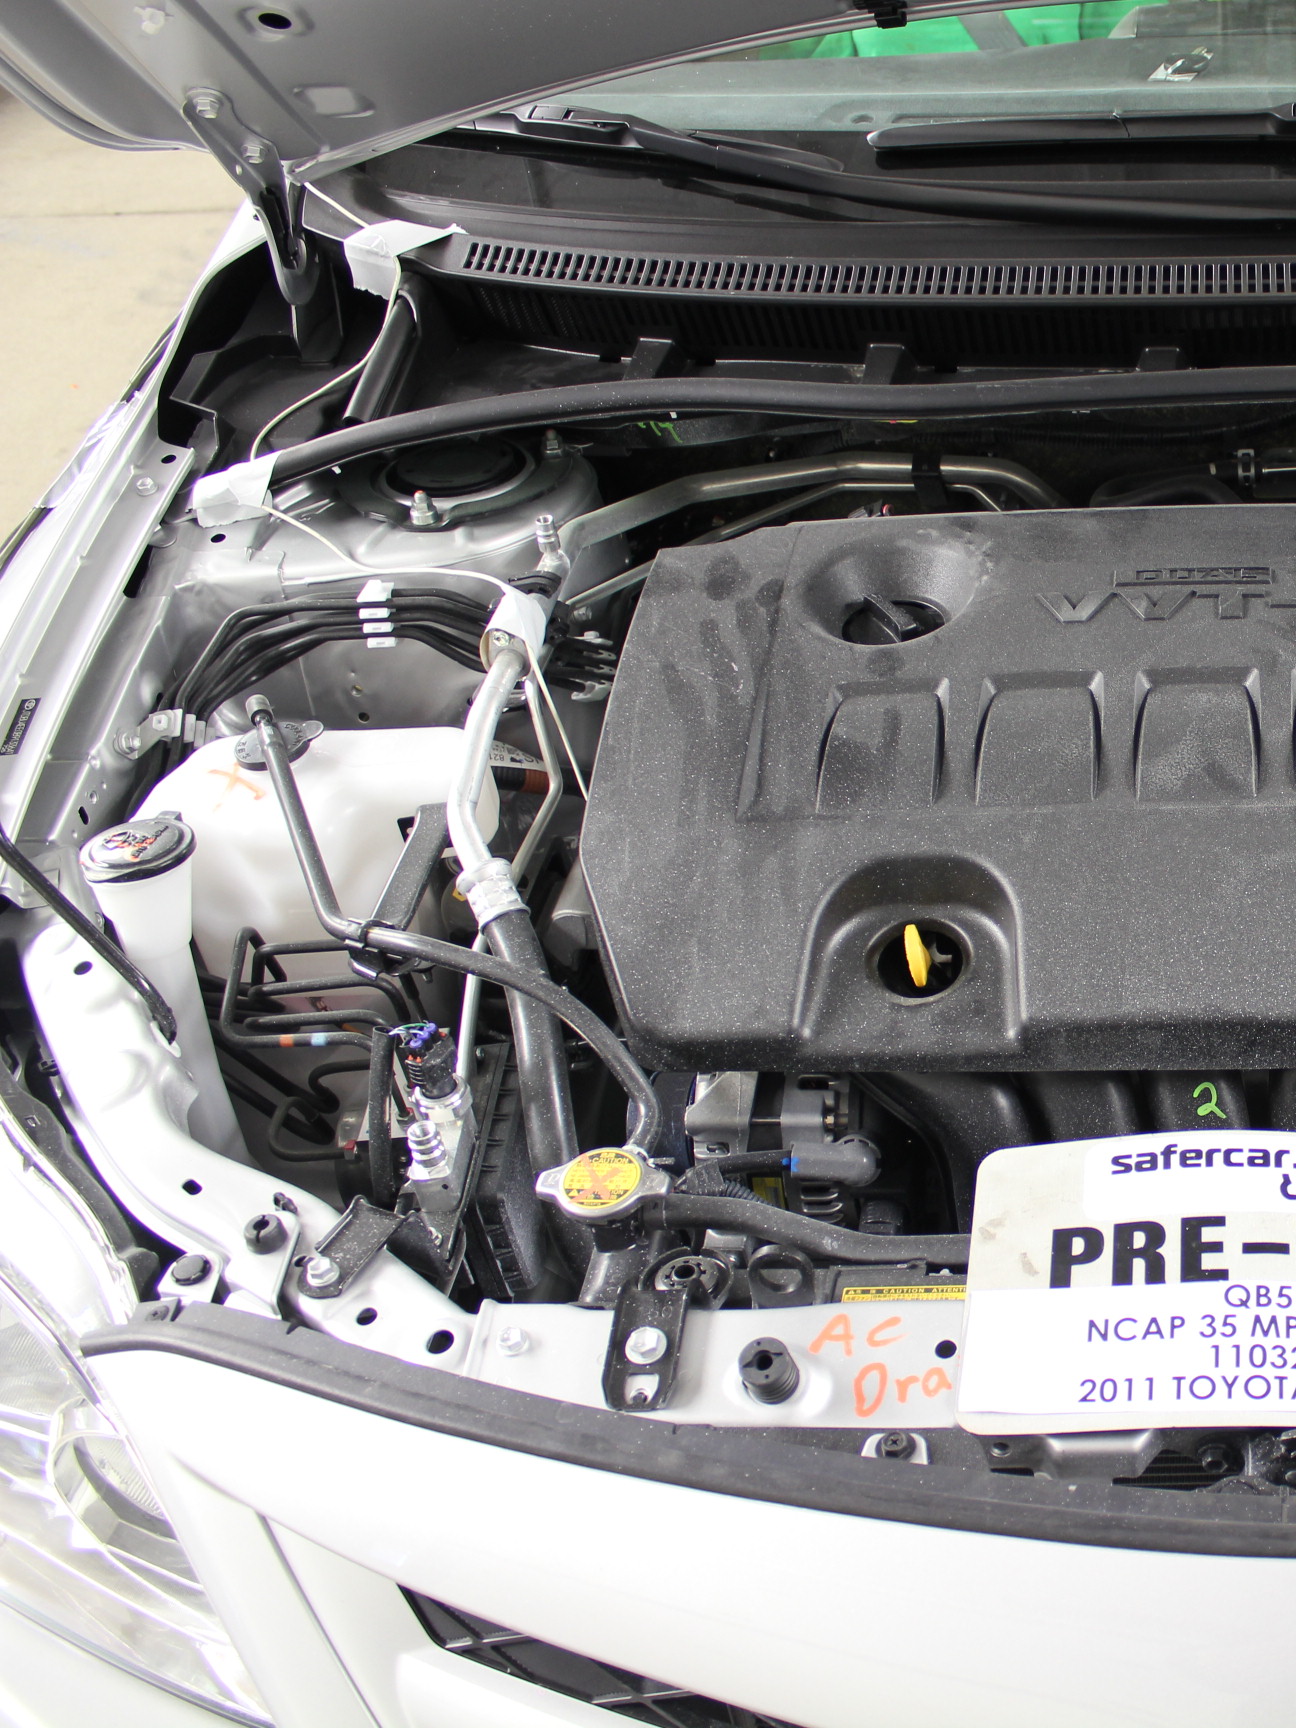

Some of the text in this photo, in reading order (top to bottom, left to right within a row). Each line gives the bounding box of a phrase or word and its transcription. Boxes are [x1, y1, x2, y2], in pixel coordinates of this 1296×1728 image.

[1193, 1081, 1227, 1119] 2
[808, 1313, 911, 1356] AC
[1087, 1316, 1185, 1342] NCAP
[1199, 1314, 1237, 1338] 35
[1078, 1377, 1154, 1403] 2011
